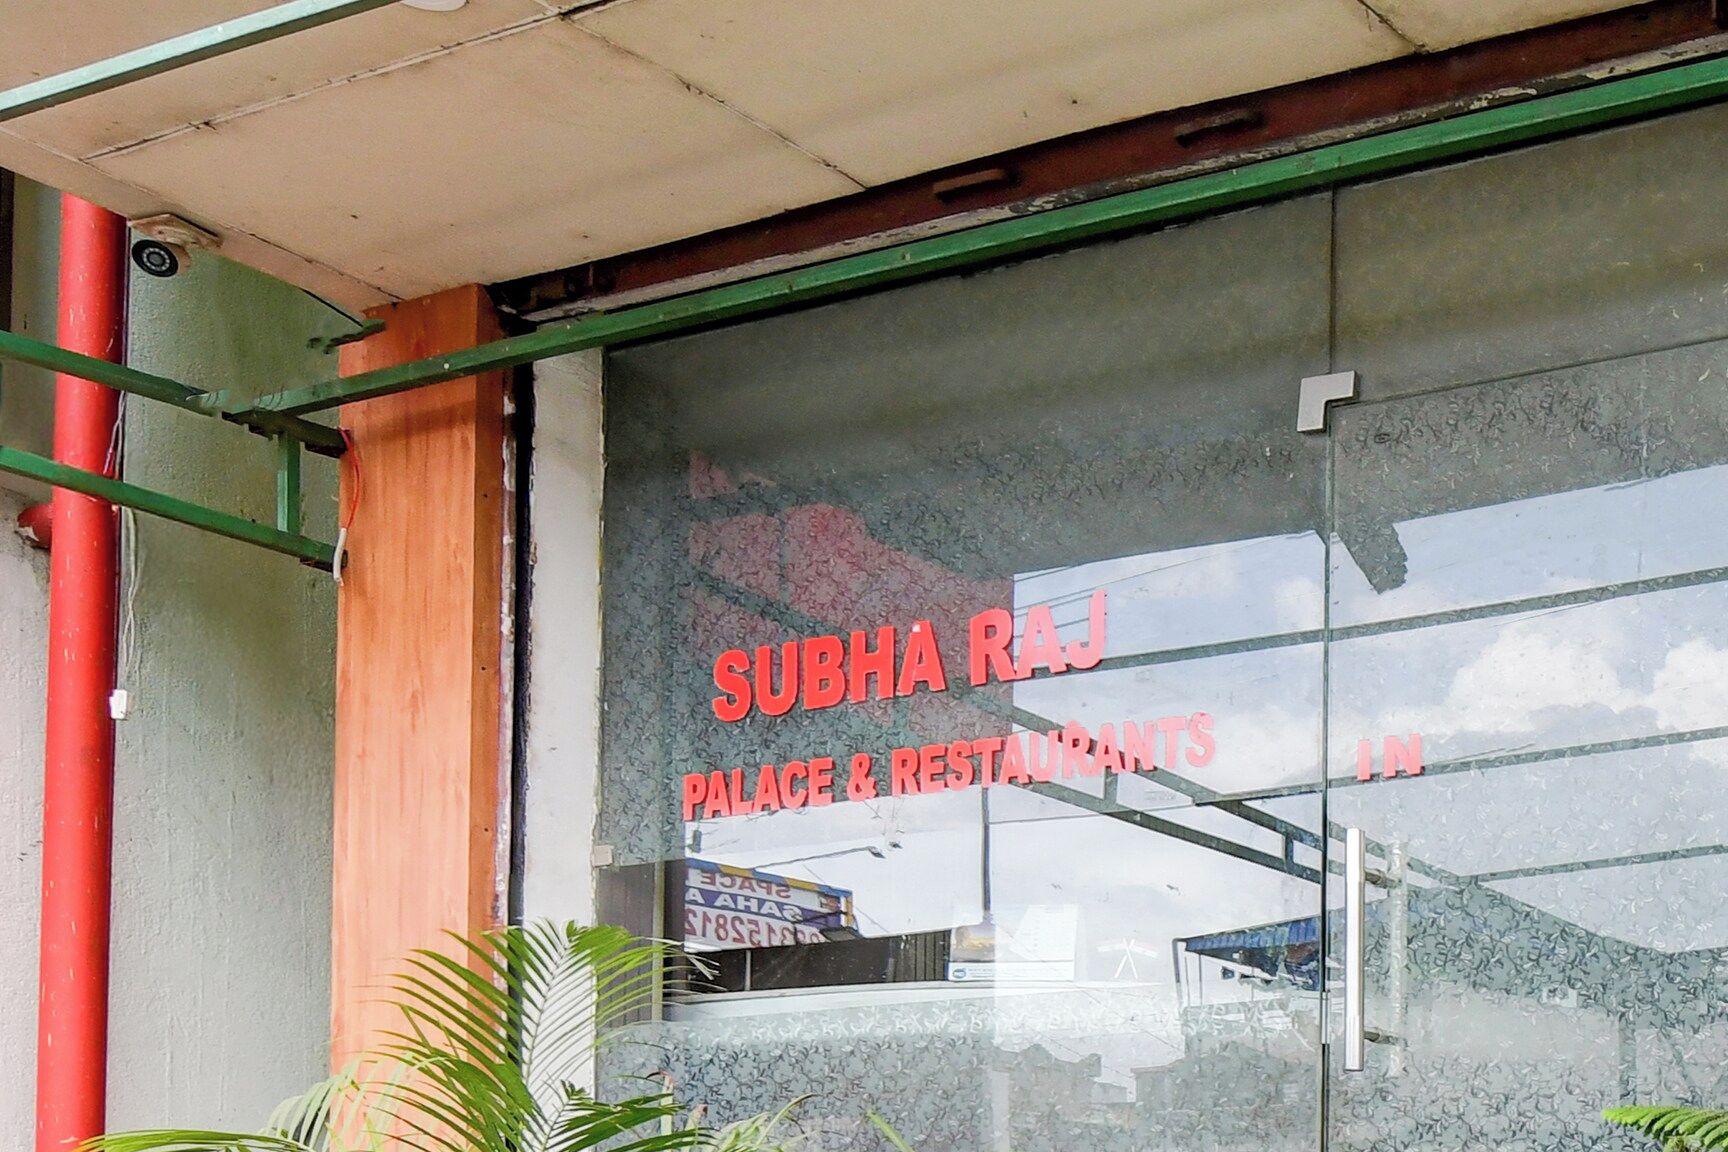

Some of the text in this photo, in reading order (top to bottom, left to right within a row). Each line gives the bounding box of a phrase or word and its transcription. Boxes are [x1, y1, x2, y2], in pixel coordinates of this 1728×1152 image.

[712, 589, 1107, 723] SUBHA RAJ
[682, 711, 1216, 821] PALACE & RESTAURANTS
[1356, 732, 1424, 782] IN
